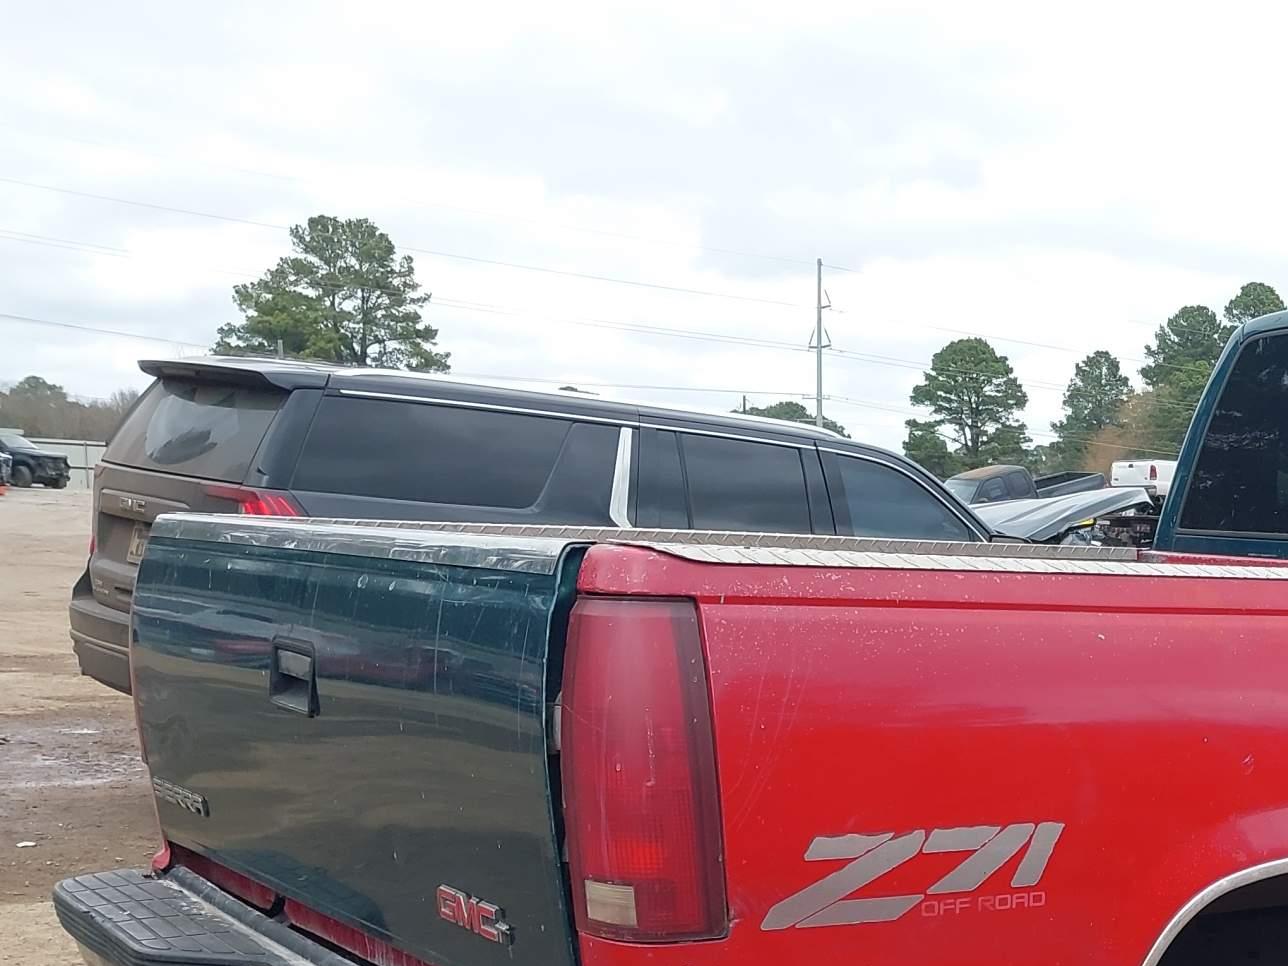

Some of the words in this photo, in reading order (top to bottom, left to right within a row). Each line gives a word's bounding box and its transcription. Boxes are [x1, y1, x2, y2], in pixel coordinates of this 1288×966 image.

[761, 821, 1065, 931] Z71
[921, 898, 970, 917] OFF
[978, 891, 1046, 911] ROAD
[437, 884, 500, 943] GMC
